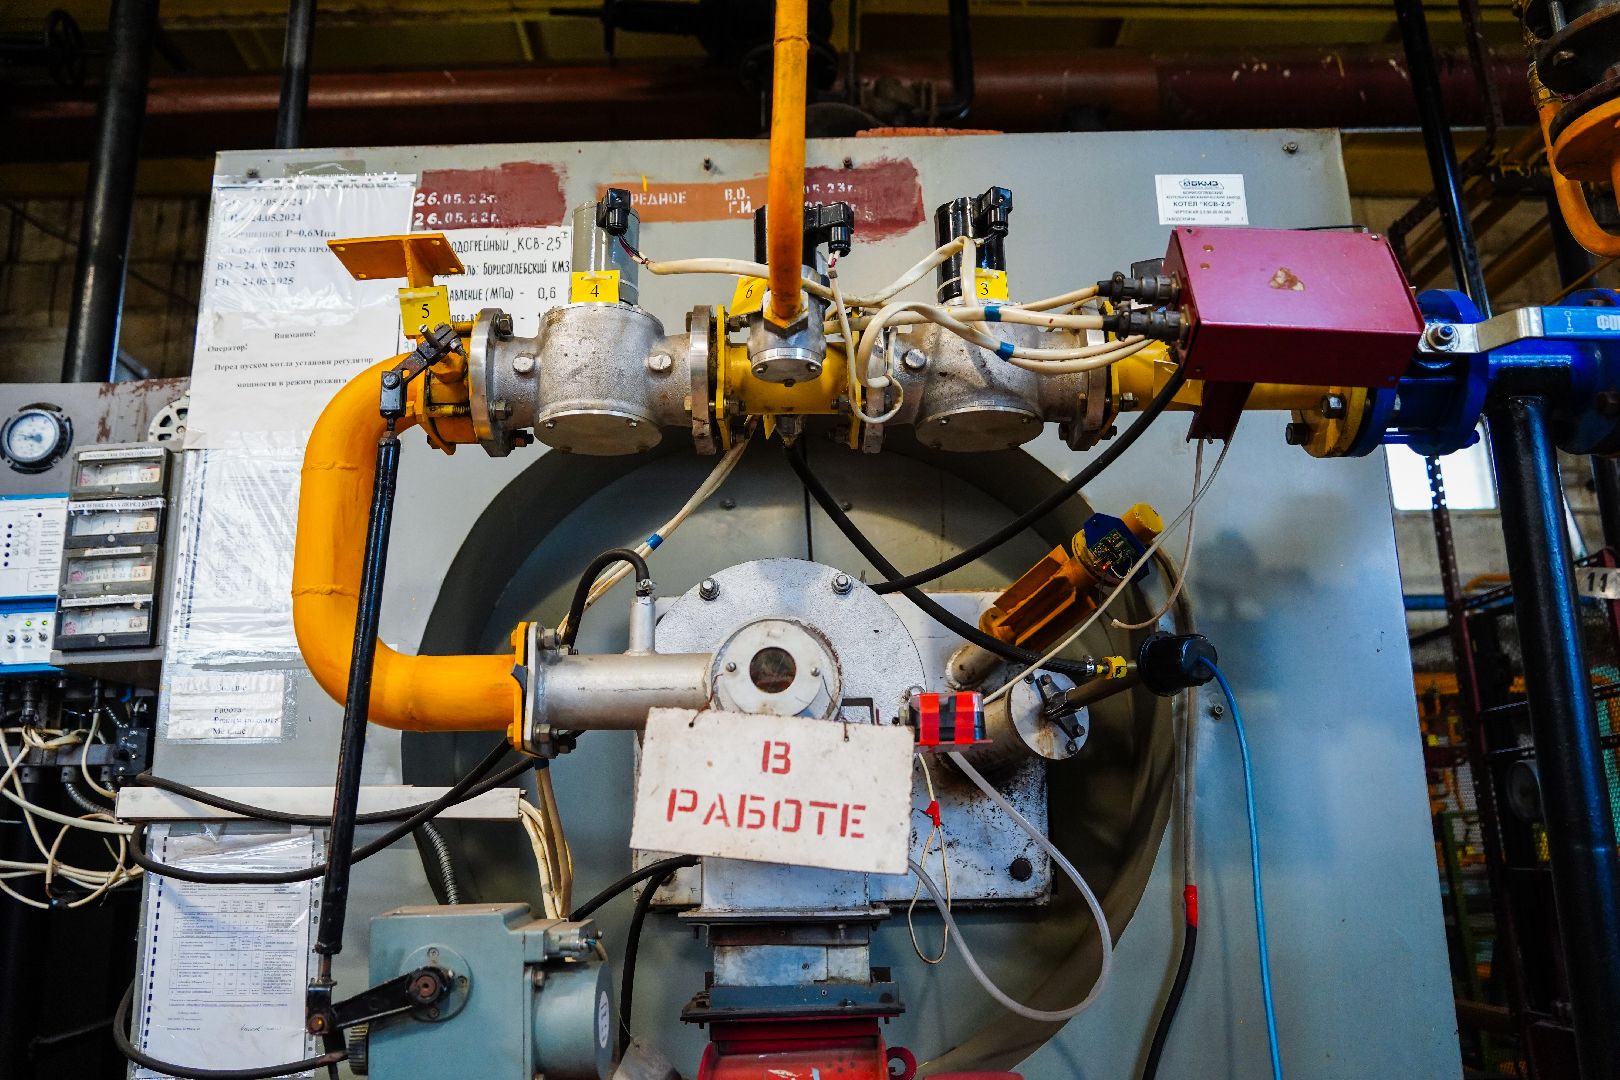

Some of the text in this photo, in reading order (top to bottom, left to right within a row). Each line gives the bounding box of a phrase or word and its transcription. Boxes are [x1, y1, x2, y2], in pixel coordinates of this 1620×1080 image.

[630, 191, 687, 206] РЕДНОЕ
[724, 187, 751, 201] В.О.
[728, 200, 757, 214] Г.И.
[452, 234, 509, 253] ОДОГРЕЙНЫЙ
[483, 259, 547, 276] БОРИСОГЛЕБСКИЙ
[552, 260, 570, 273] КМЗ
[449, 288, 483, 301] АВЛЕНИЕ
[537, 286, 556, 300] 0,6
[590, 284, 600, 299] 4
[746, 284, 754, 298] 6
[980, 282, 989, 296] 3
[421, 303, 430, 319] 5
[214, 363, 238, 372] Перед
[240, 362, 268, 370] пуском
[295, 359, 332, 368] установи
[286, 379, 312, 387] режим
[1587, 572, 1609, 593] 11
[761, 740, 792, 775] В
[665, 787, 867, 839] РАБОТЕ
